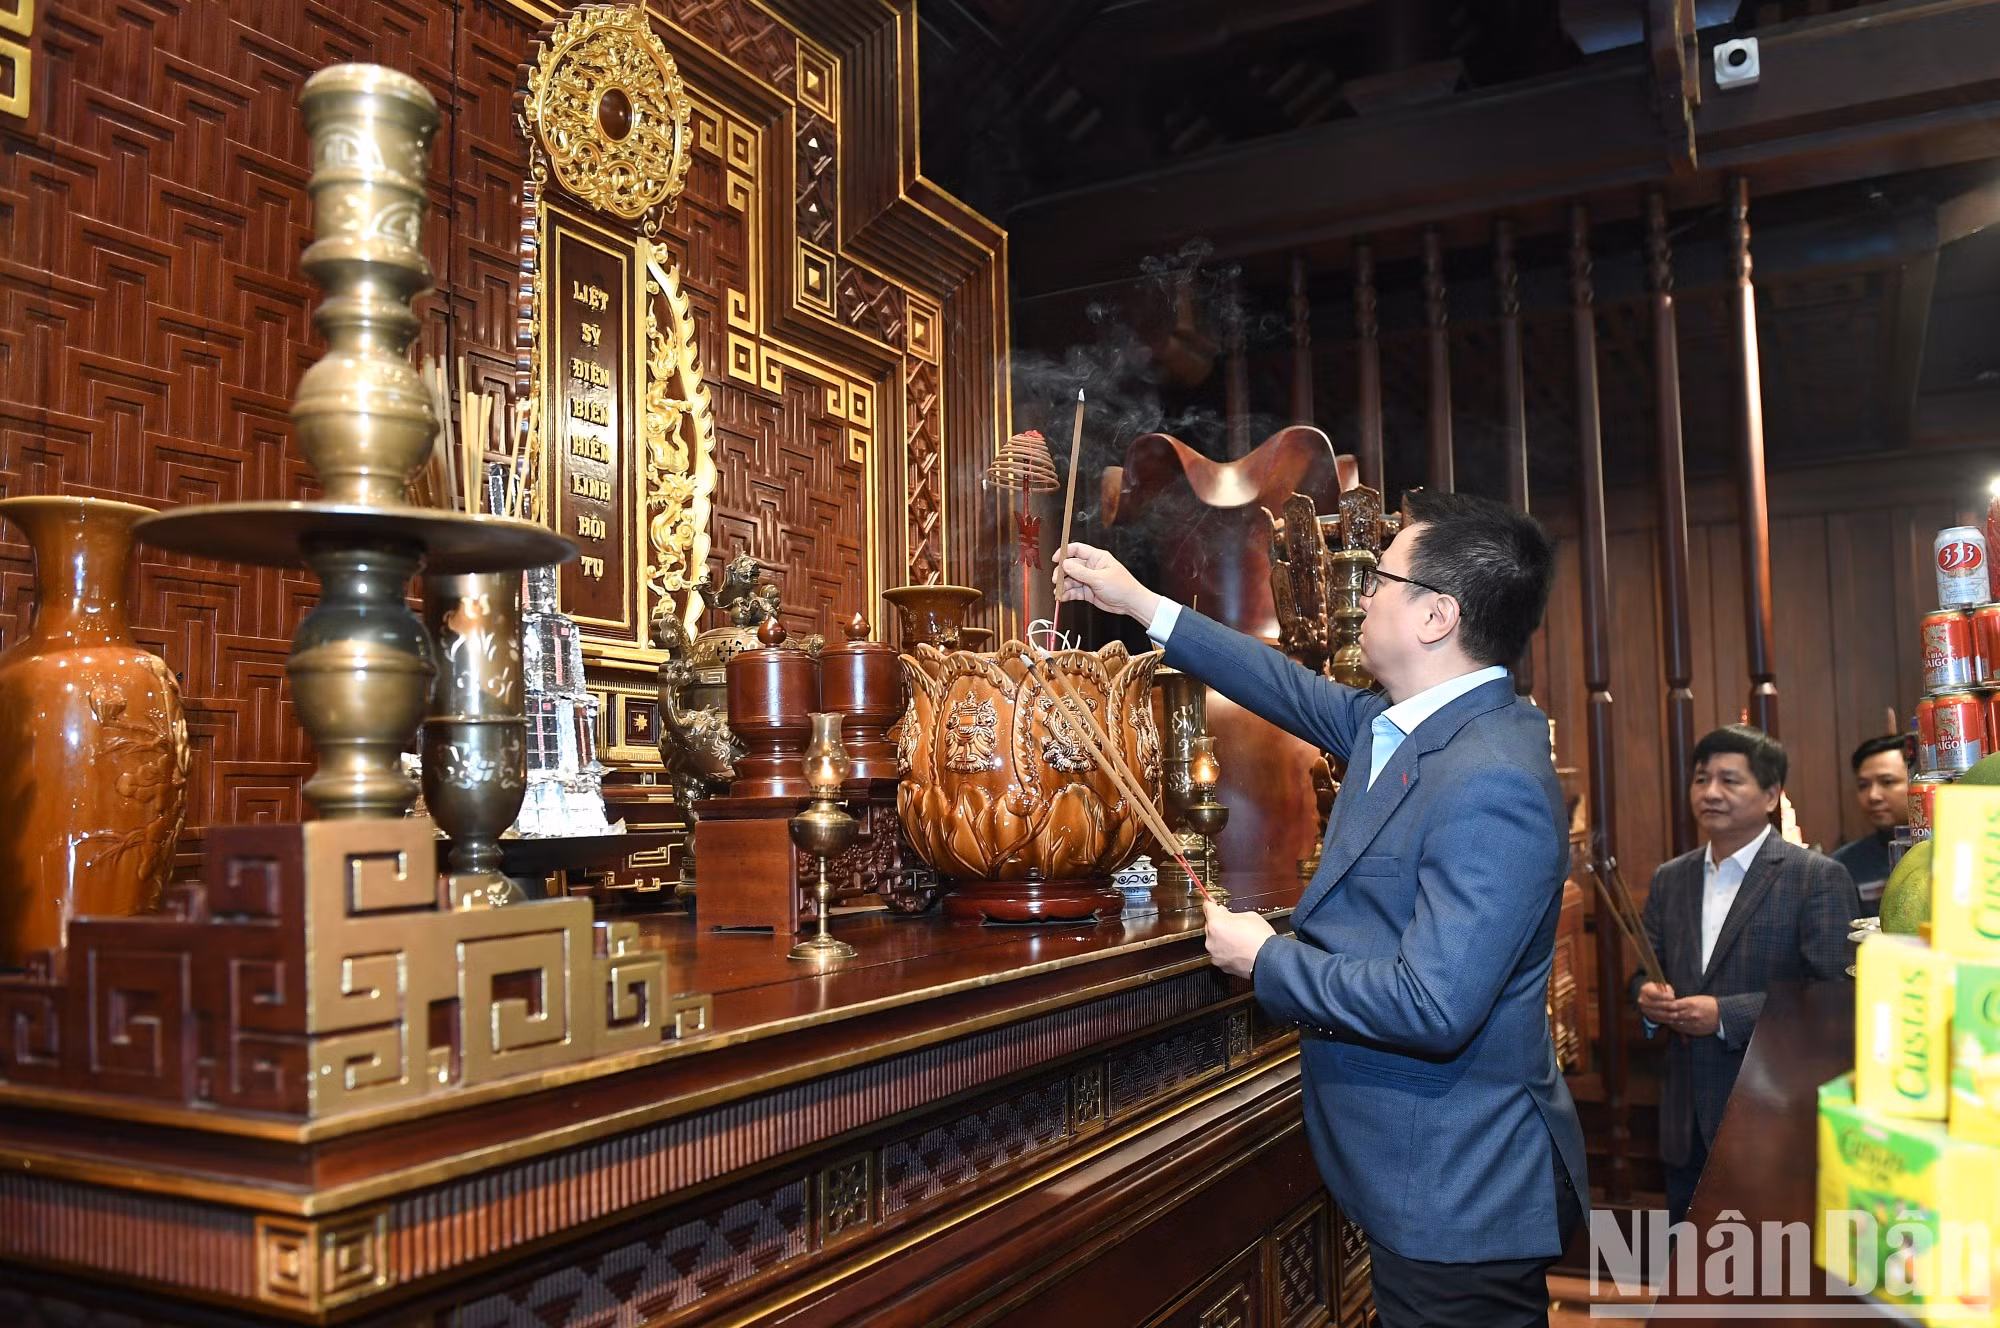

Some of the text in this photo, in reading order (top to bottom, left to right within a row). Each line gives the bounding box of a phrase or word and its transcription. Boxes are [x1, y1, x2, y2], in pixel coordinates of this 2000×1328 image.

[573, 280, 609, 312] LIỆT
[572, 472, 611, 502] LINH
[578, 513, 606, 542] HỘI
[581, 556, 604, 582] TỤ
[1942, 539, 1974, 569] 333
[1895, 968, 1929, 1100] Custas
